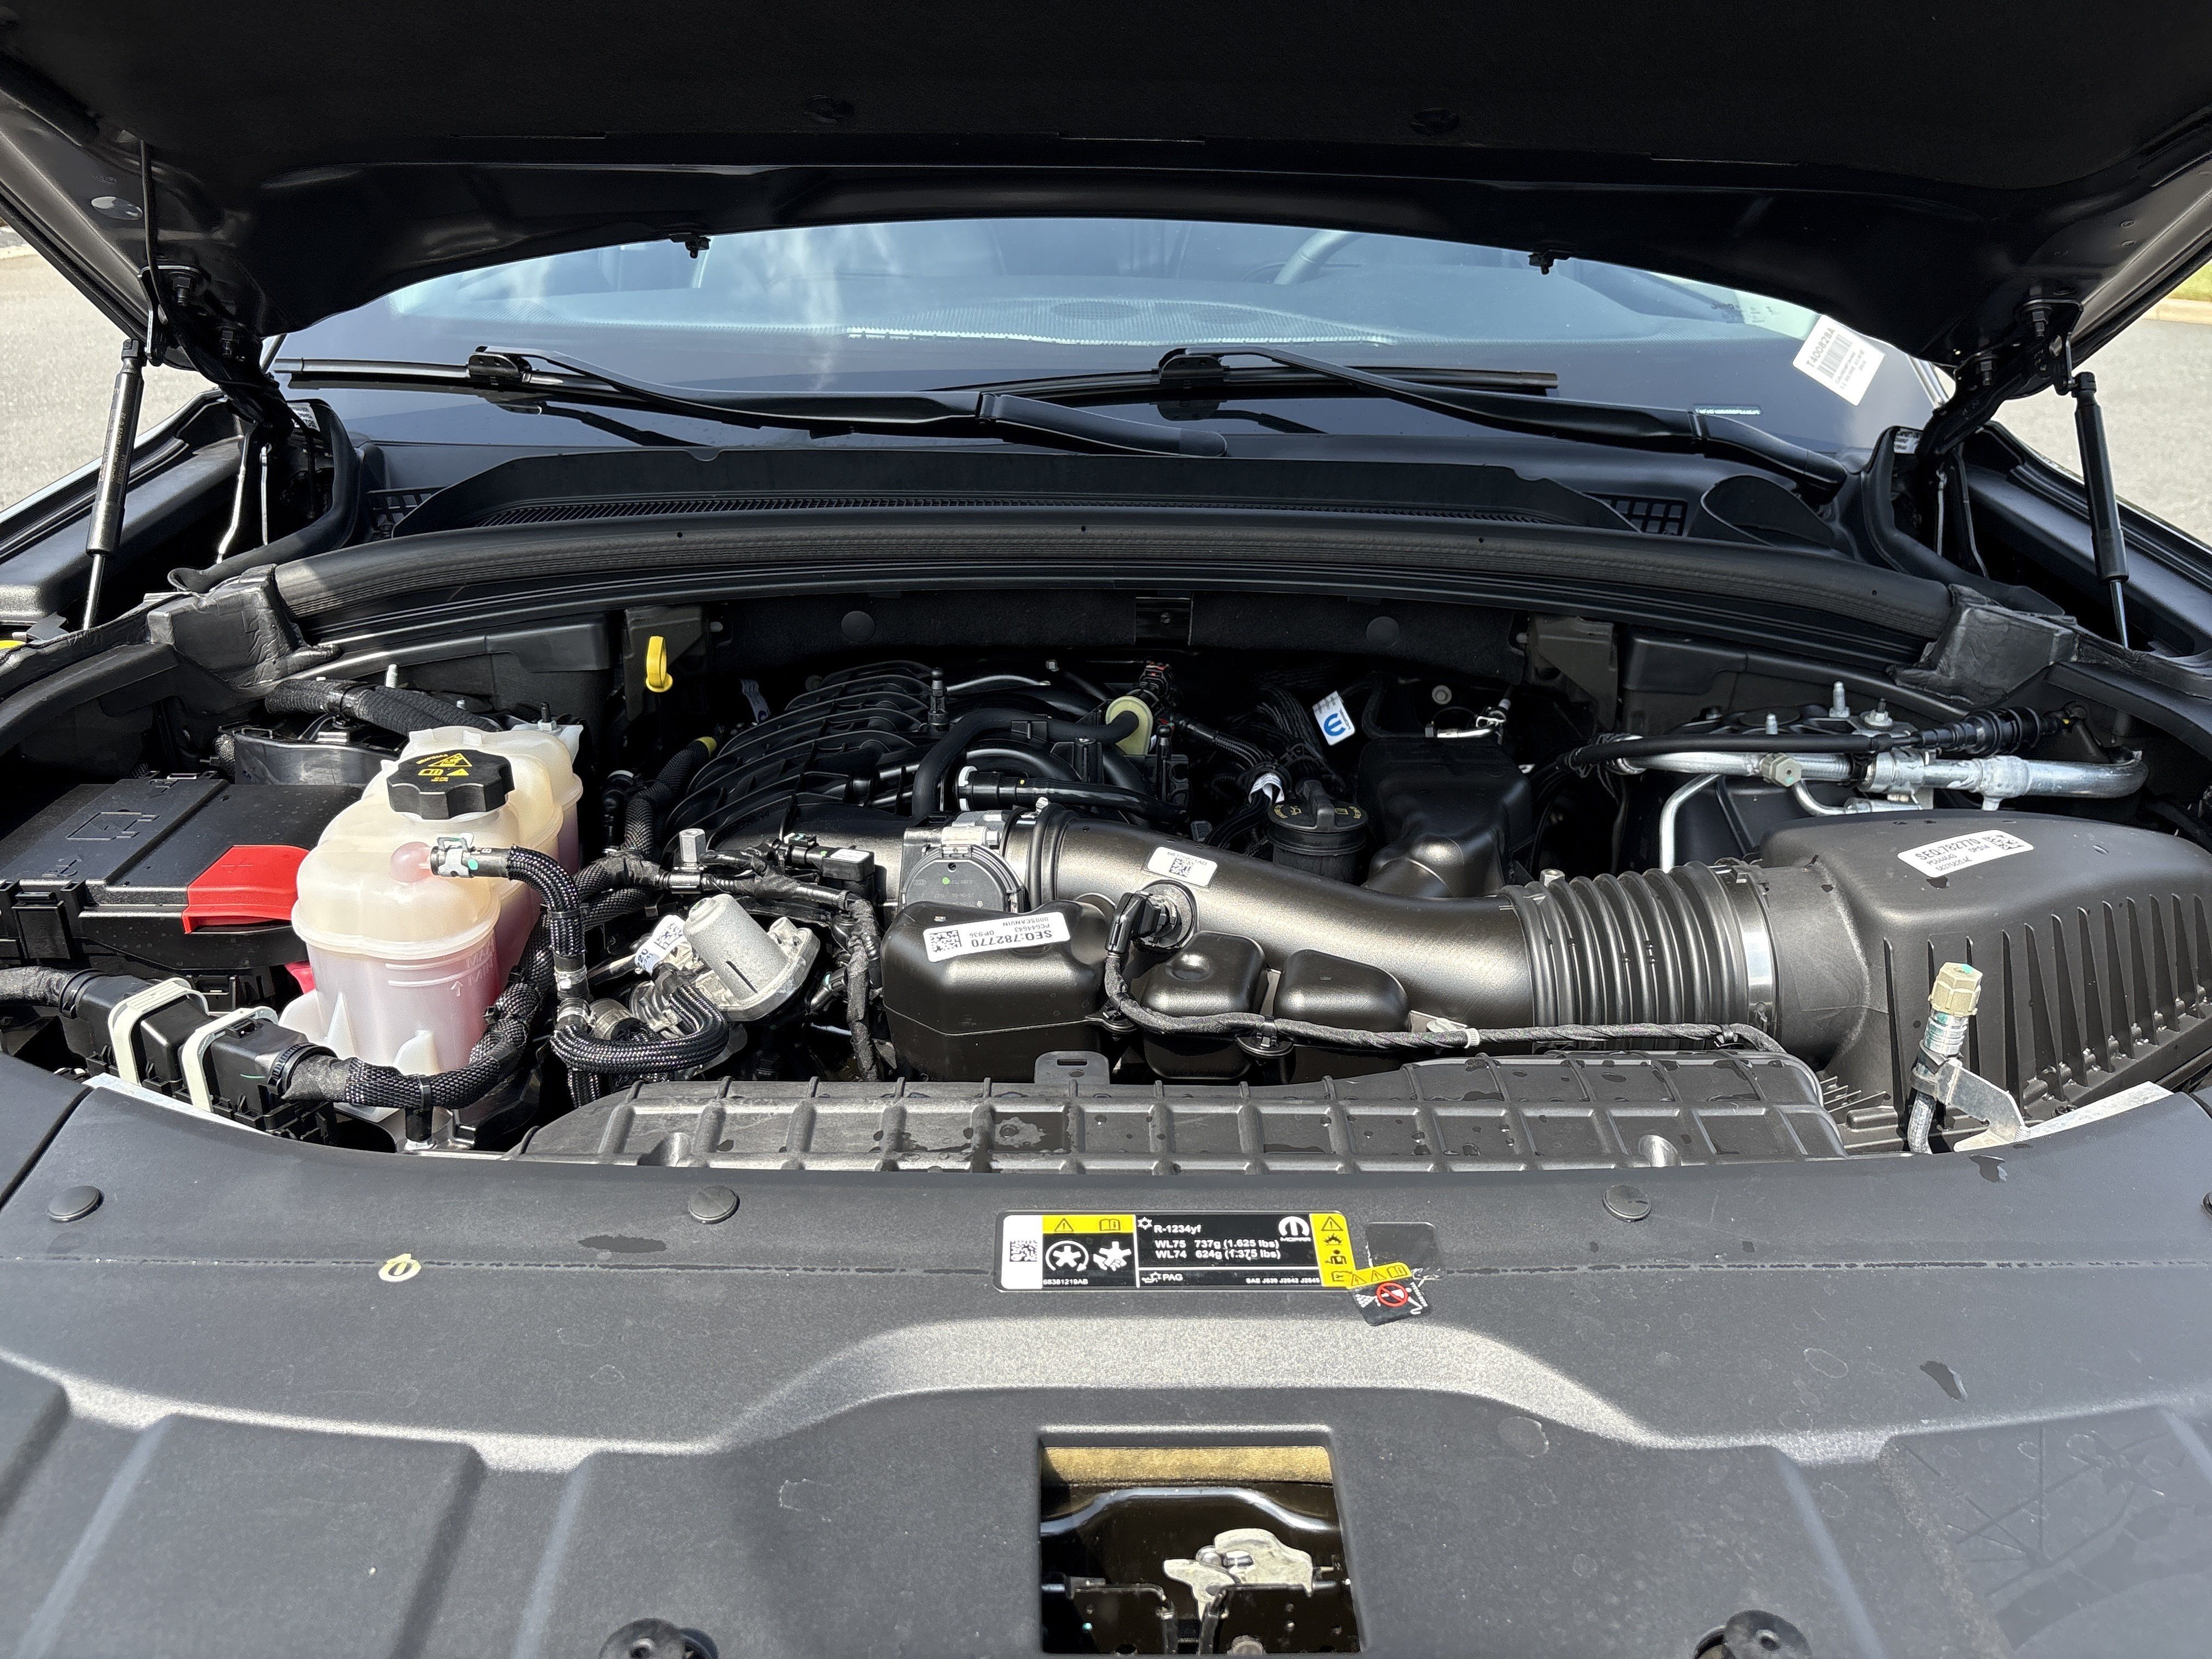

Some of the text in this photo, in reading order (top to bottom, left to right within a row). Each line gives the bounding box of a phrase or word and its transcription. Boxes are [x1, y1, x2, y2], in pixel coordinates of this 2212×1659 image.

[971, 930, 1052, 948] SEQ:782770
[1154, 1224, 1201, 1234] R-1234yf
[1154, 1239, 1279, 1249] WL75 737g (1.625 lbs)
[1155, 1250, 1281, 1260] WL74 624g (1.375 lbs)
